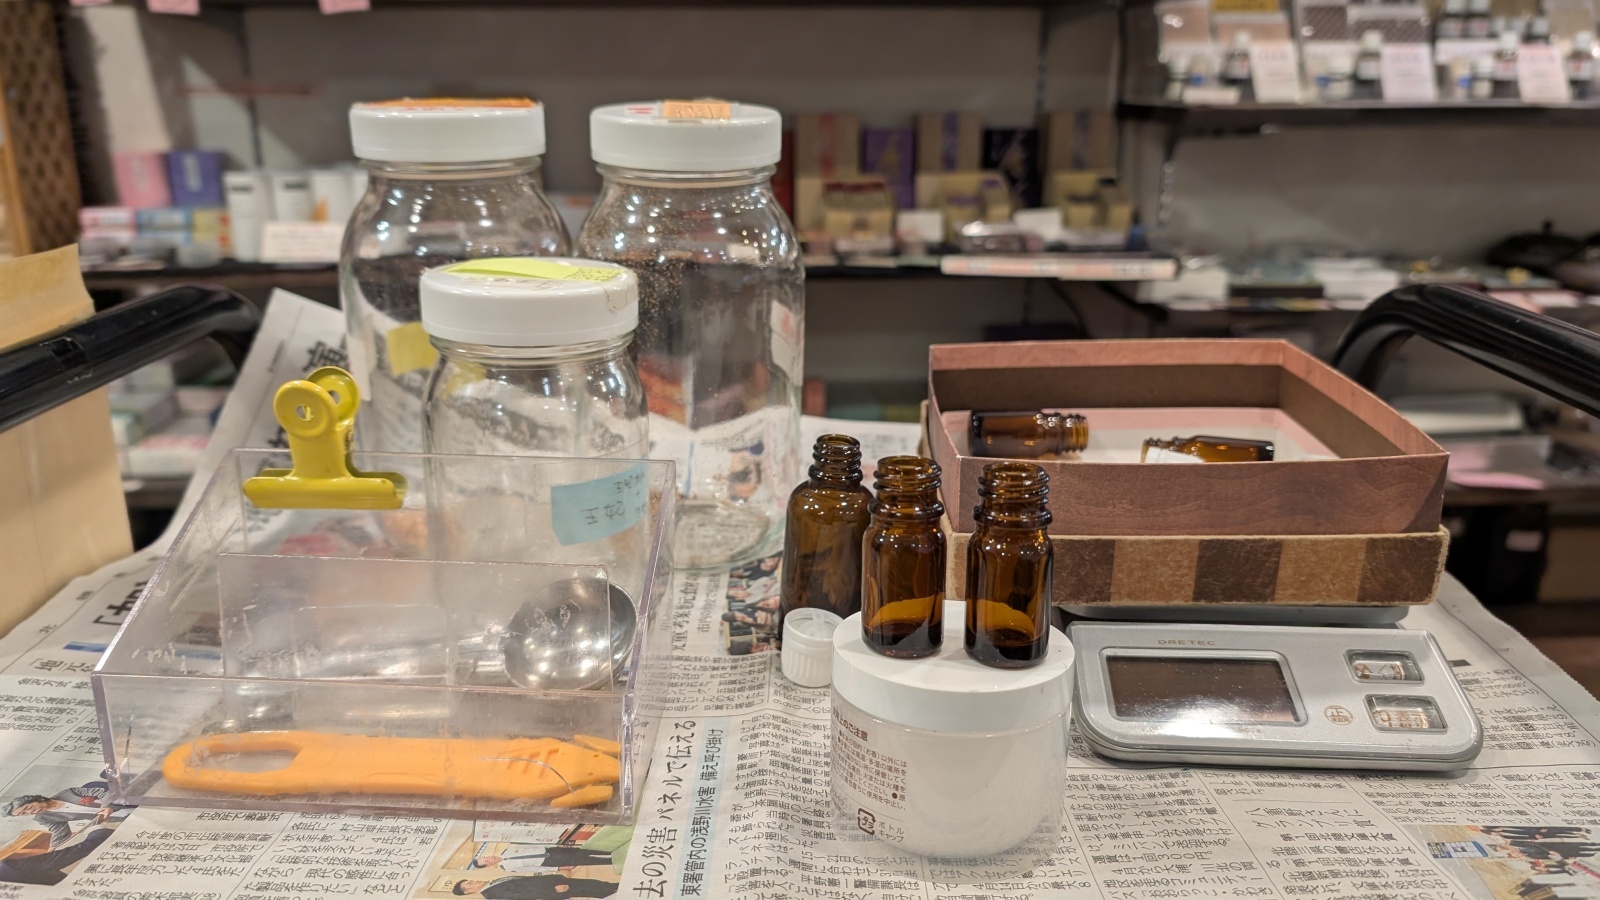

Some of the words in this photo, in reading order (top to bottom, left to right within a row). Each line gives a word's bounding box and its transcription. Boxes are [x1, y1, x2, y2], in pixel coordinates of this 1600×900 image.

[657, 720, 697, 821] パネルで伝える
[700, 728, 723, 781] 備え呼び掛け
[633, 826, 678, 899] 去の災害
[680, 786, 717, 897] 東署管内の浅野川水害
